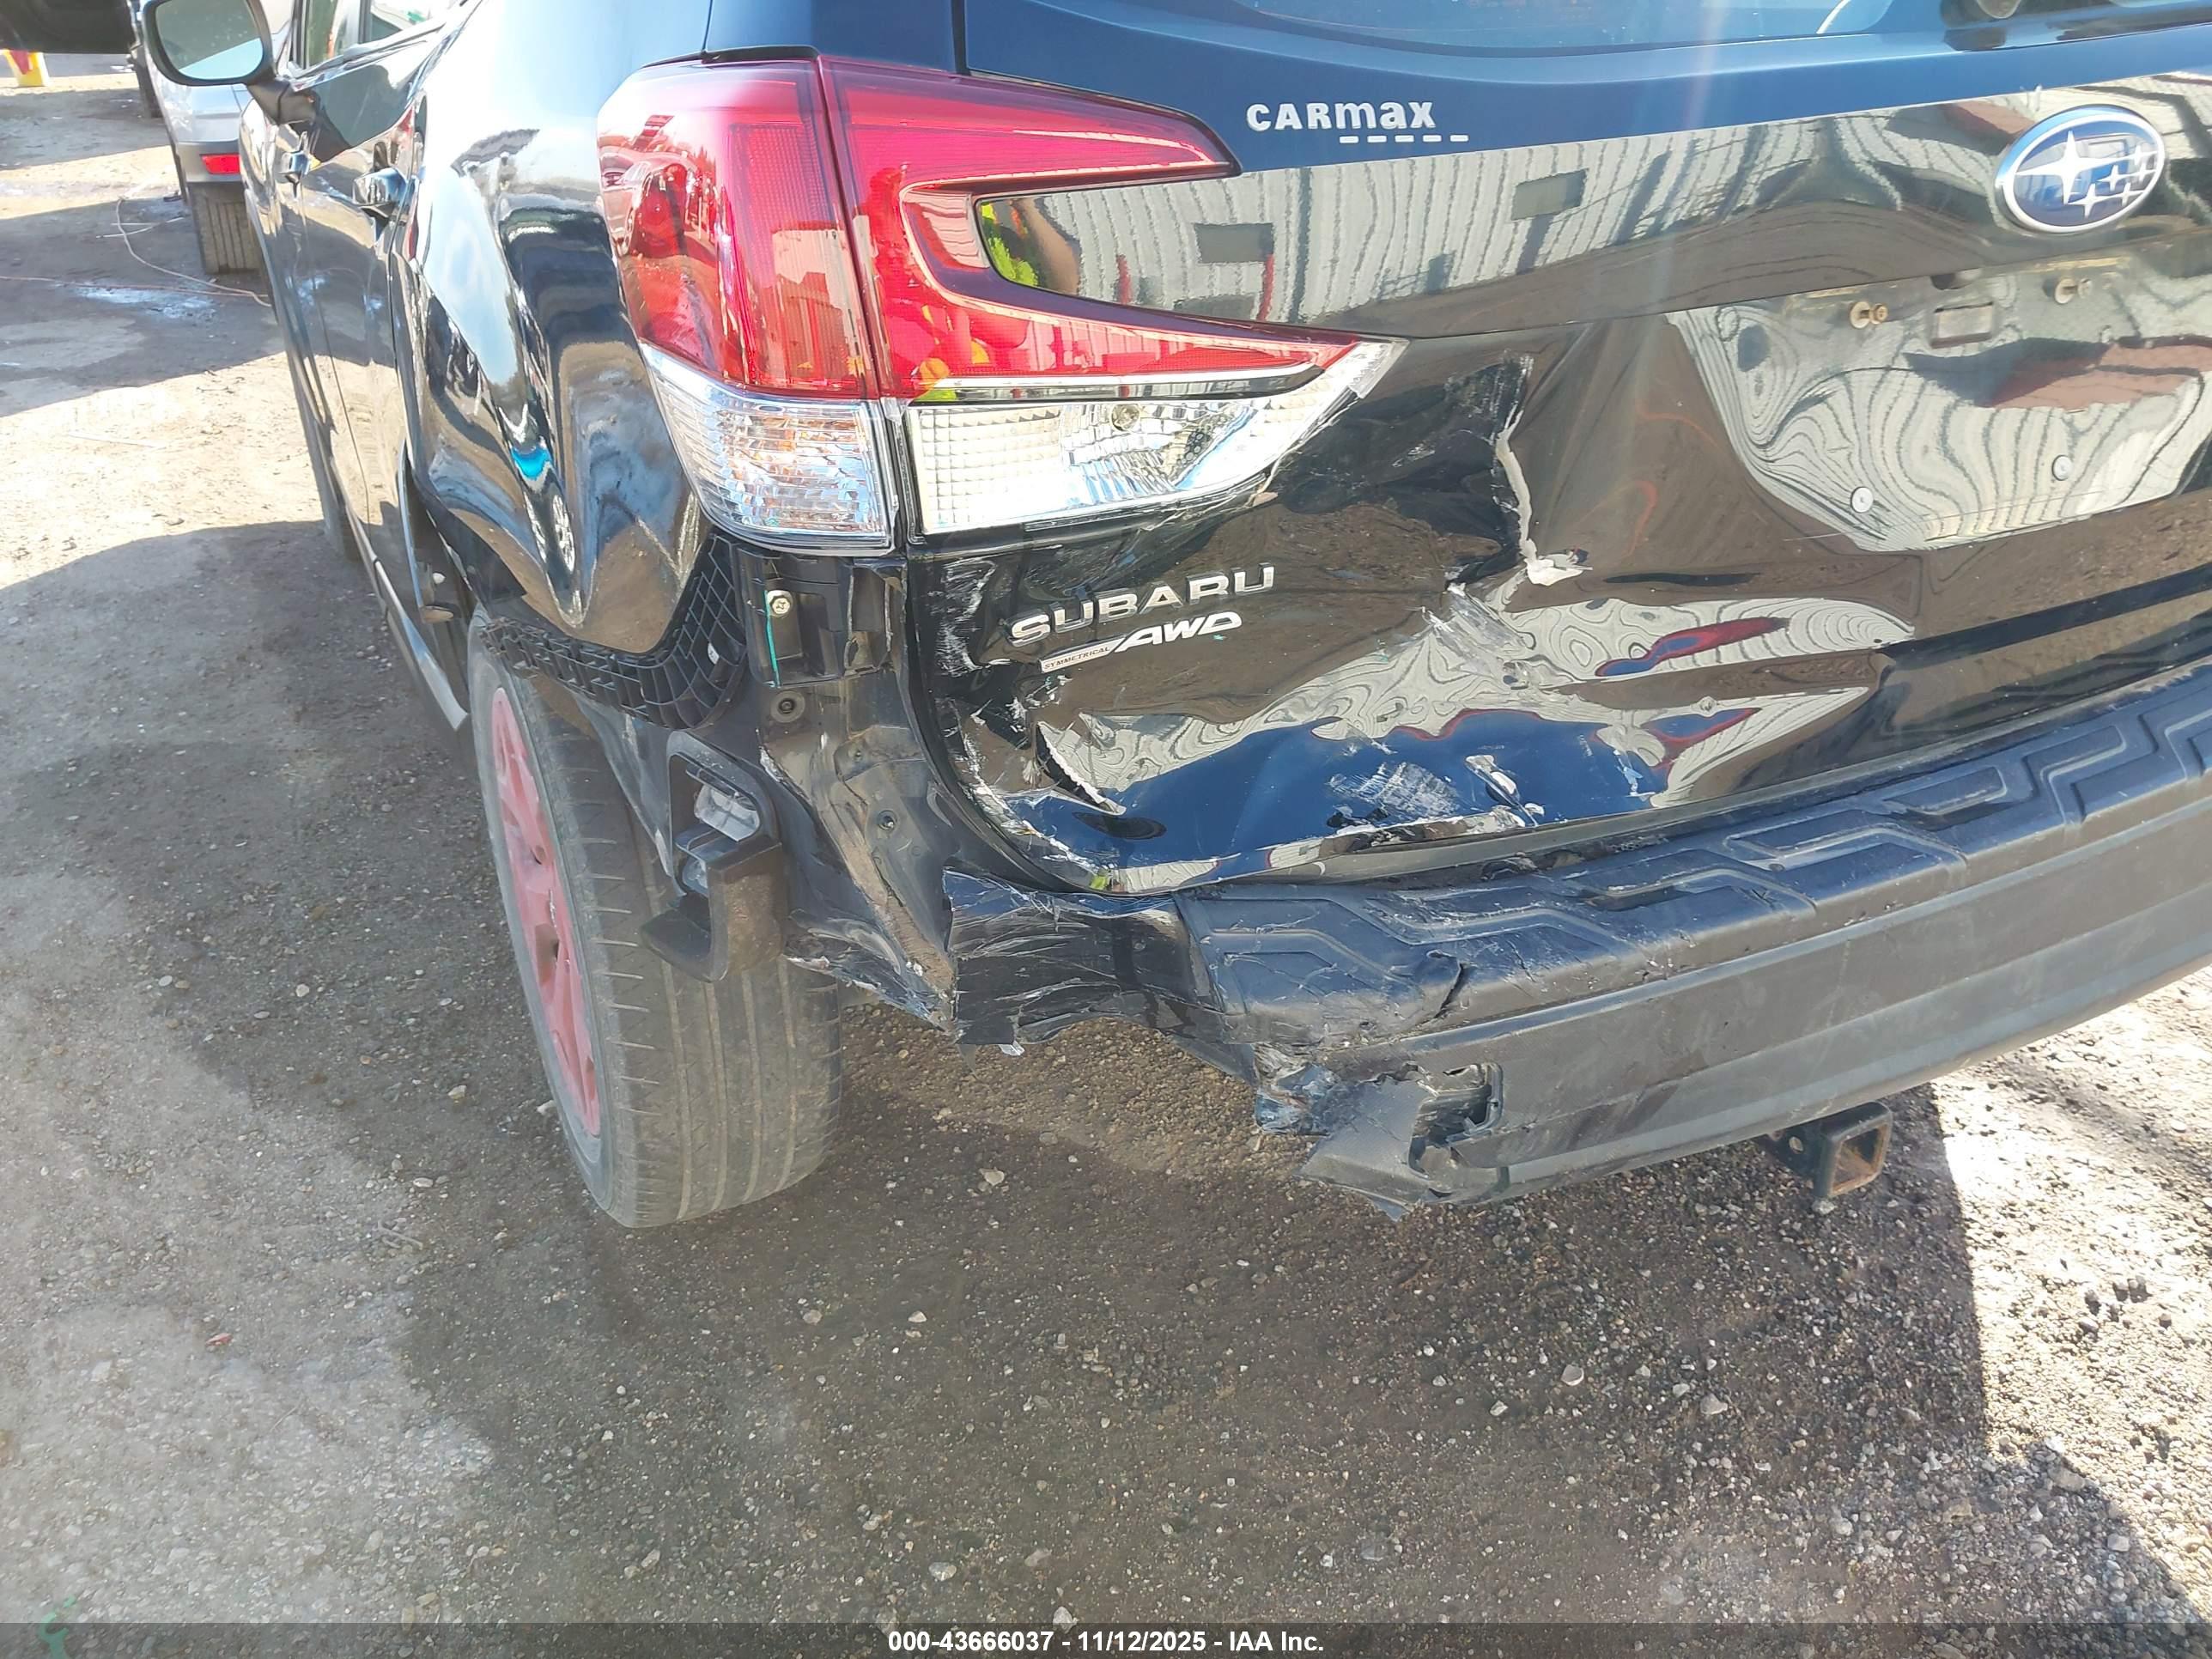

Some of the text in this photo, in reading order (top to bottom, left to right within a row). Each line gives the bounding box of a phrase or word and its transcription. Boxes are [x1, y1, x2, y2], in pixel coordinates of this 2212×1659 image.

[1246, 101, 1437, 131] CARmax
[1006, 562, 1275, 647] SUBARU
[1043, 611, 1243, 670] SYMMETRICAL AWD
